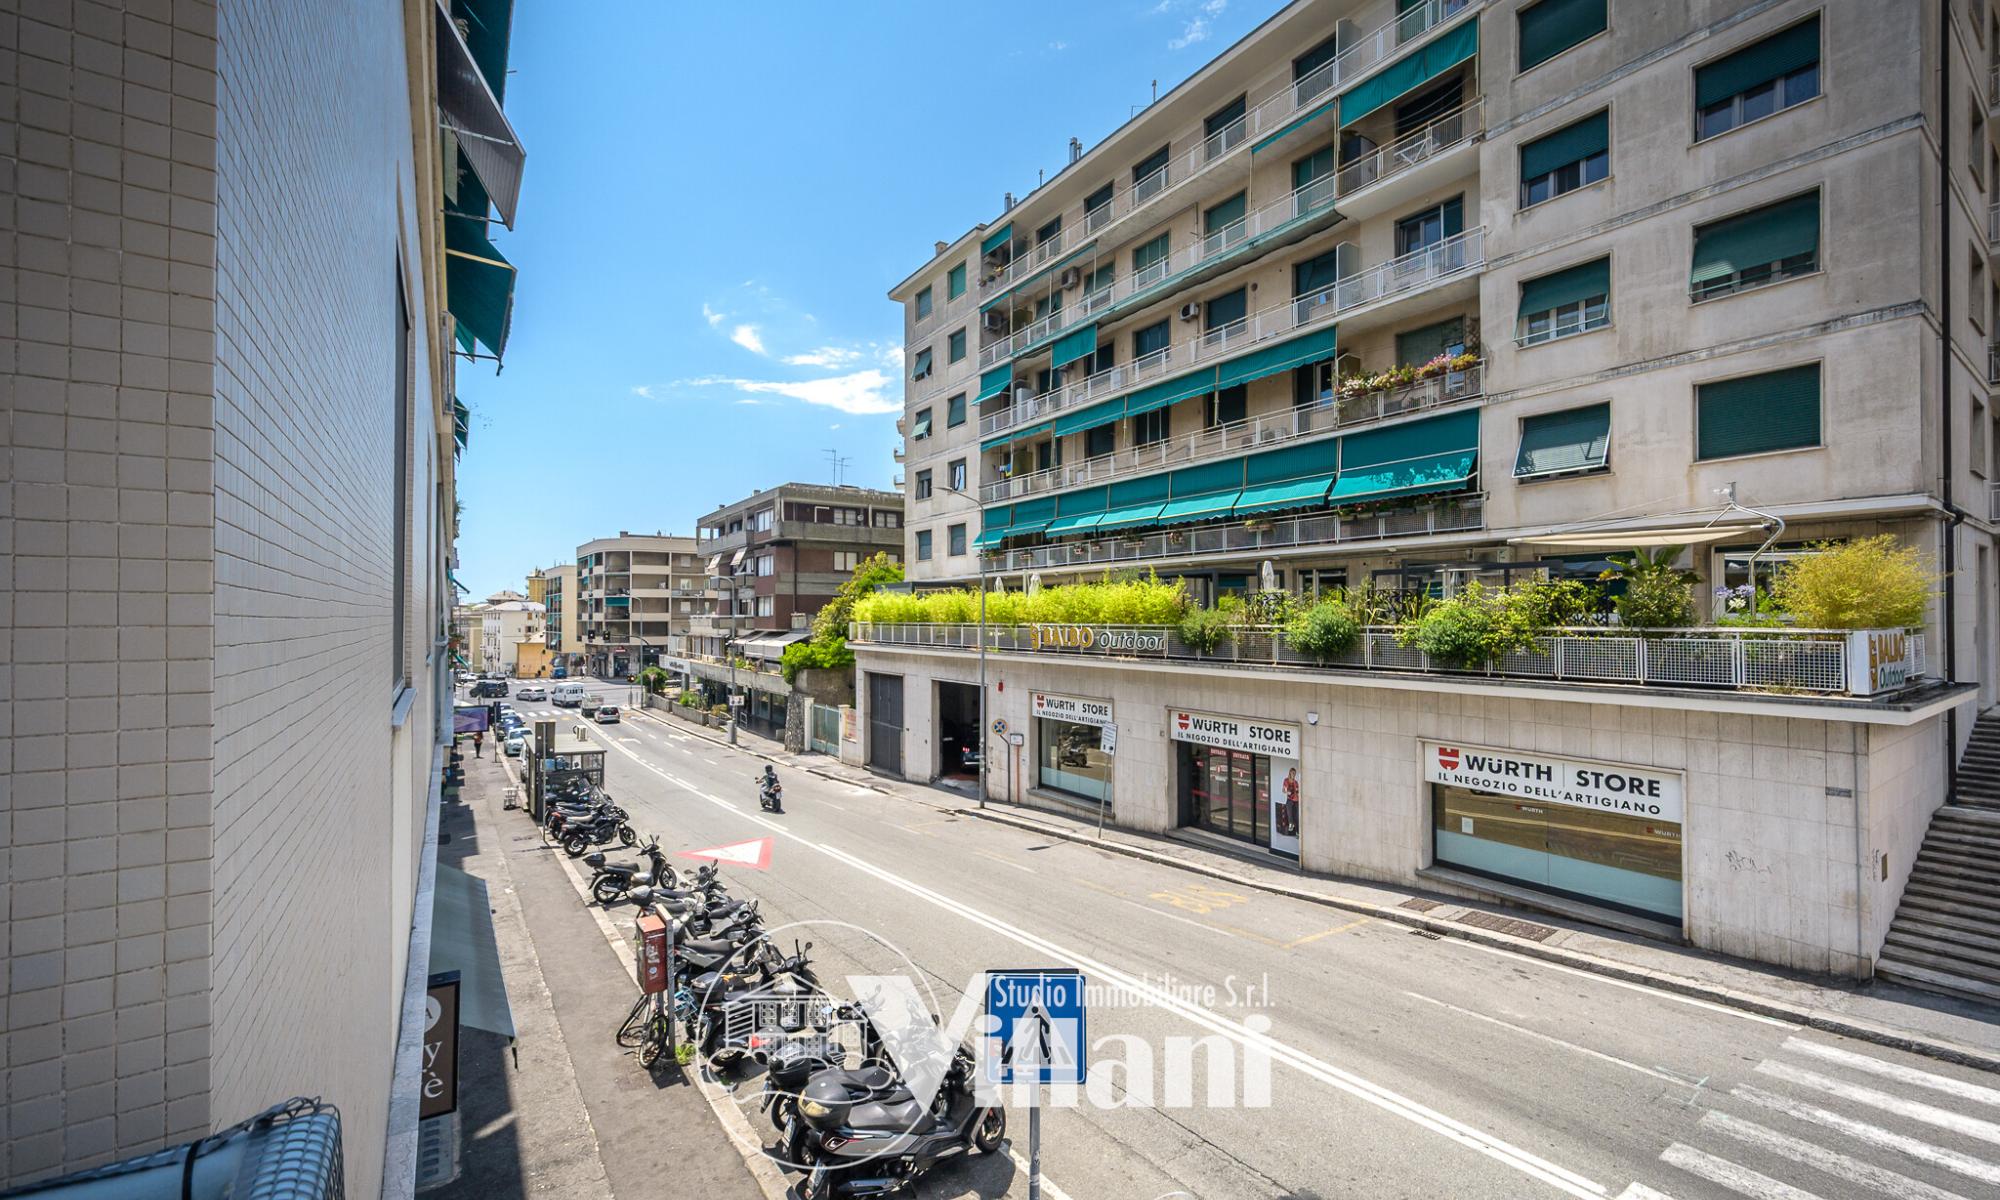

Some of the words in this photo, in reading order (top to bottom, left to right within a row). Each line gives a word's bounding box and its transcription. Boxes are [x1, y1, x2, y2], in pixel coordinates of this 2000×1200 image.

[1099, 632, 1166, 650] Outdoor
[1042, 711, 1064, 719] NEGOZIO
[1065, 714, 1108, 724] DELL'ARTIGIAN
[1046, 698, 1075, 711] WÜRTH
[1082, 703, 1108, 716] STORE
[1192, 718, 1238, 736] WÜRTH
[1249, 726, 1291, 743] STORE
[1186, 733, 1220, 744] NEGOZIO
[1223, 739, 1291, 755] DELL'ARTIGIANO
[1465, 754, 1552, 782] WÜRTH
[1576, 769, 1661, 798] STORE
[1438, 772, 1448, 781] IL
[1454, 775, 1517, 792] NEGOZIO
[1524, 785, 1661, 815] DELL'ARTIGIANO
